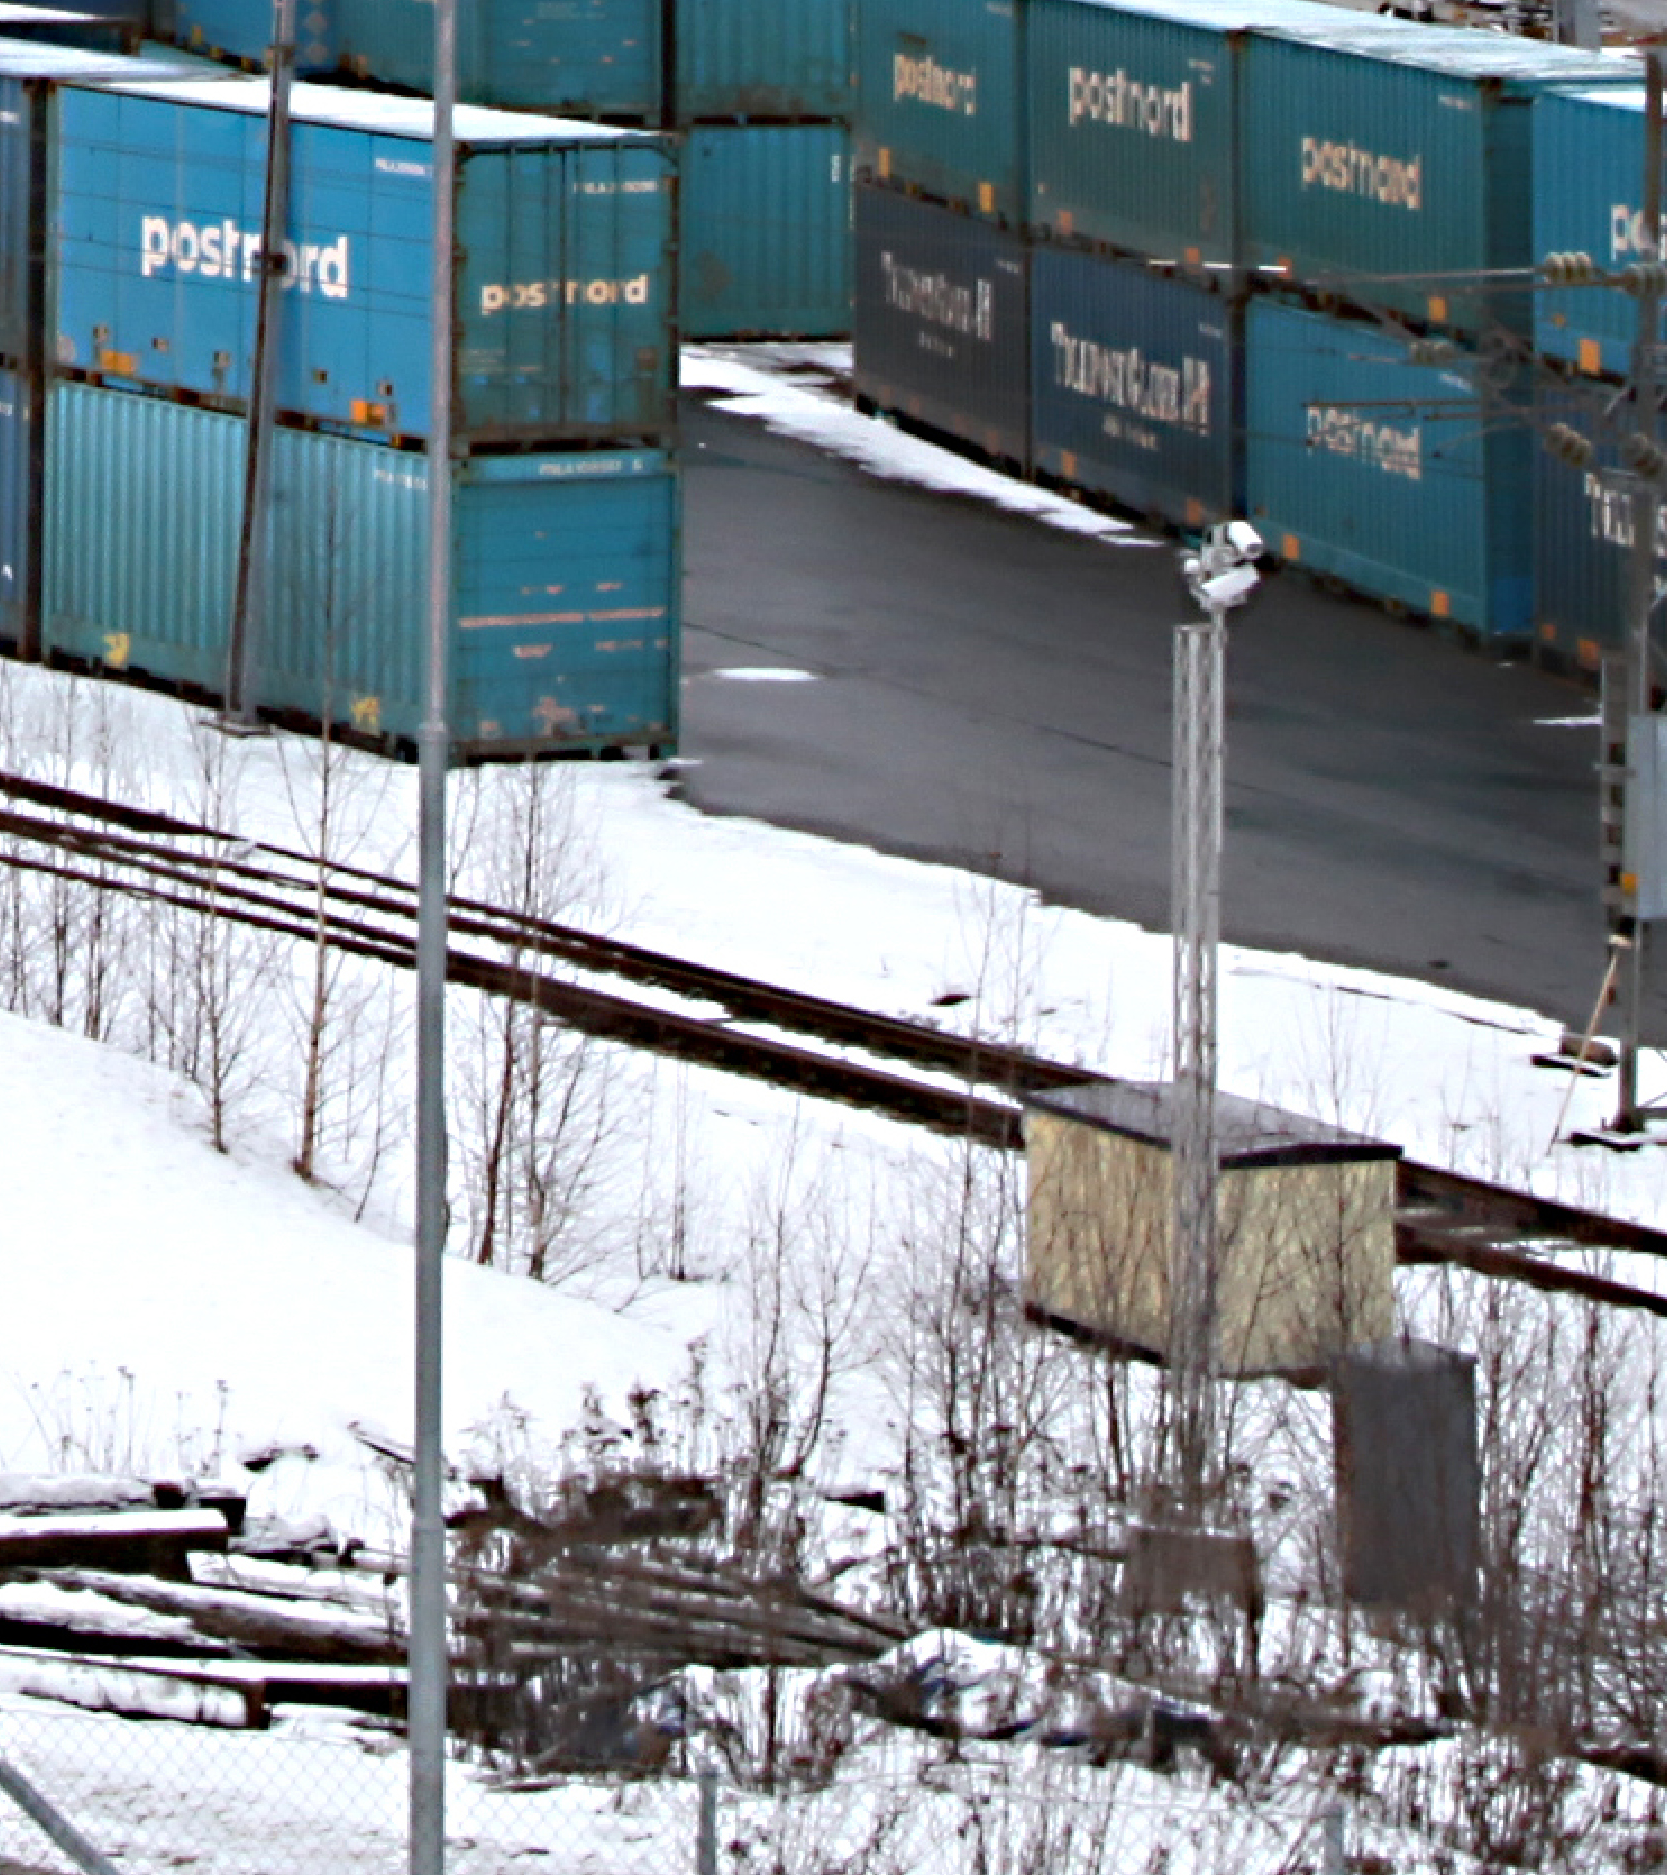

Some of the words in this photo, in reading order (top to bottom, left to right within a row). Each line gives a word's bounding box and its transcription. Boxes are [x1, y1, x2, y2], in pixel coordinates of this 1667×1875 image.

[1069, 67, 1192, 141] postnord
[1303, 137, 1422, 210] postnord
[482, 274, 649, 316] posnord
